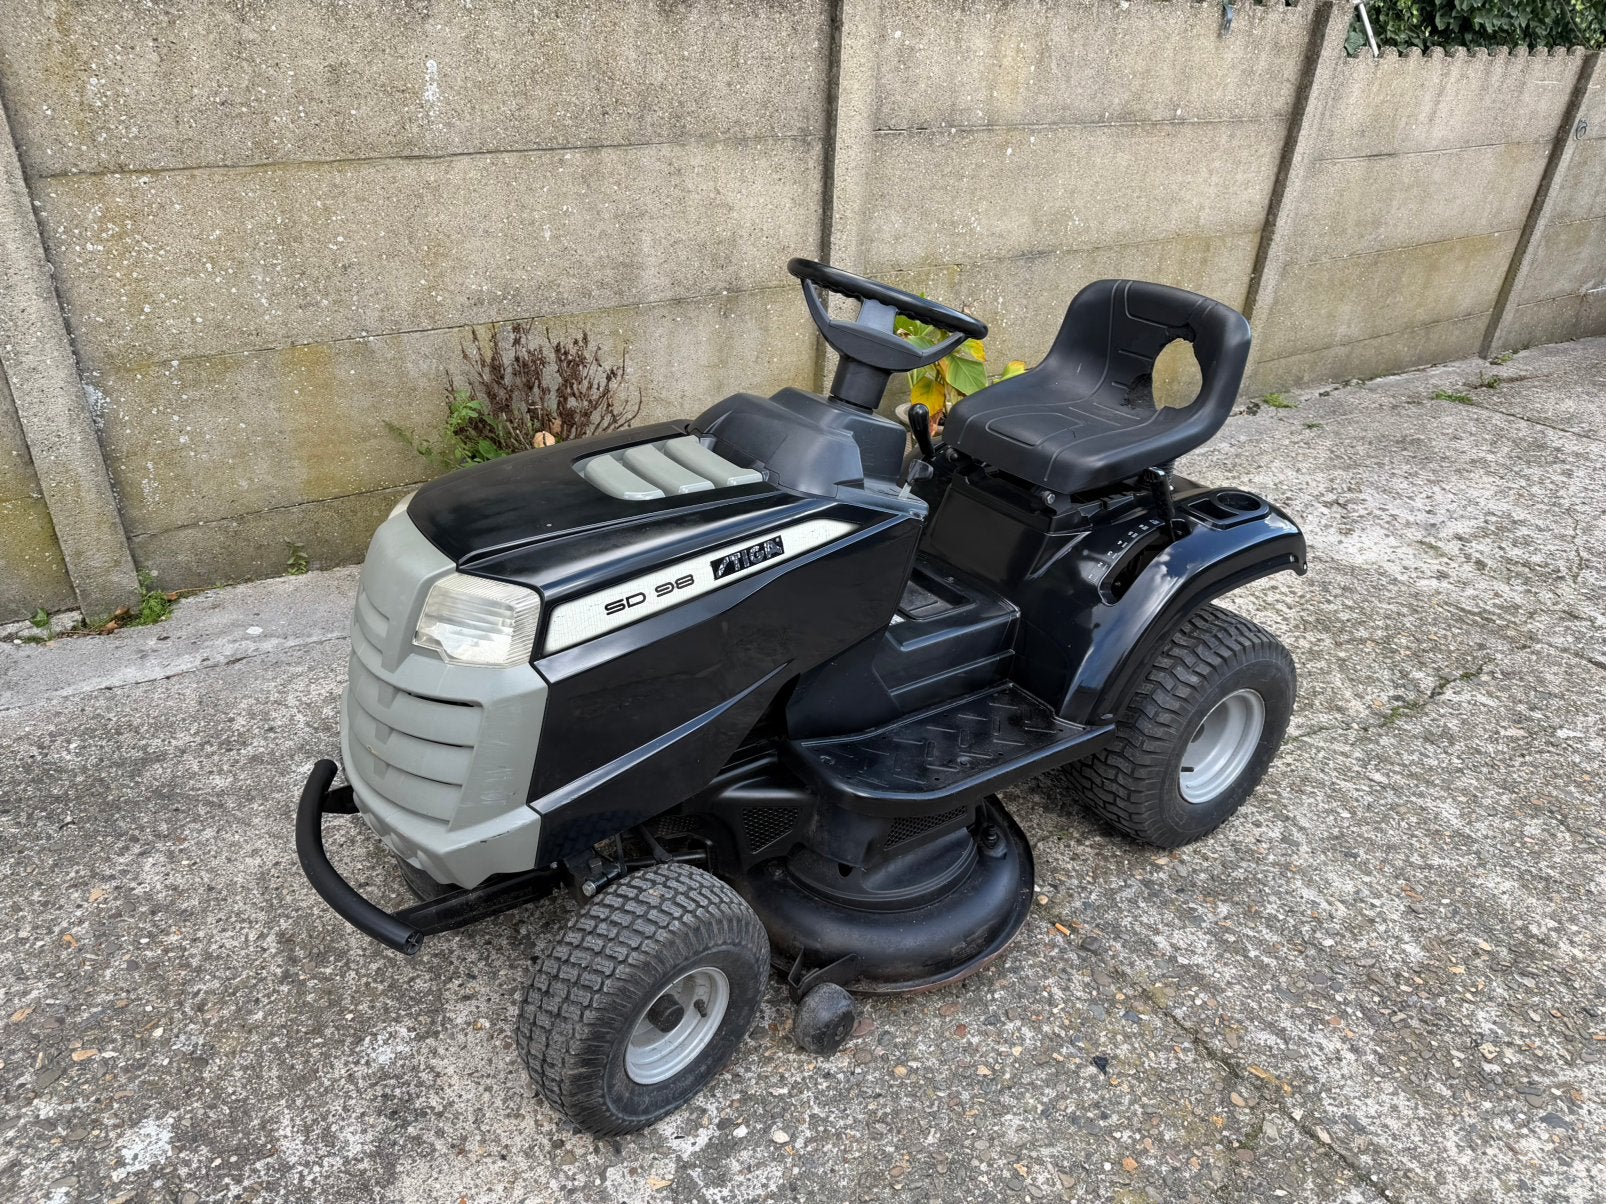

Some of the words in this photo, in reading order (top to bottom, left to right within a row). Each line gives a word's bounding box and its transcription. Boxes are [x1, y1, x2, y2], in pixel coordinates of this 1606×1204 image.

[715, 539, 782, 578] STIGA
[604, 591, 647, 616] SD
[654, 573, 695, 598] 98
